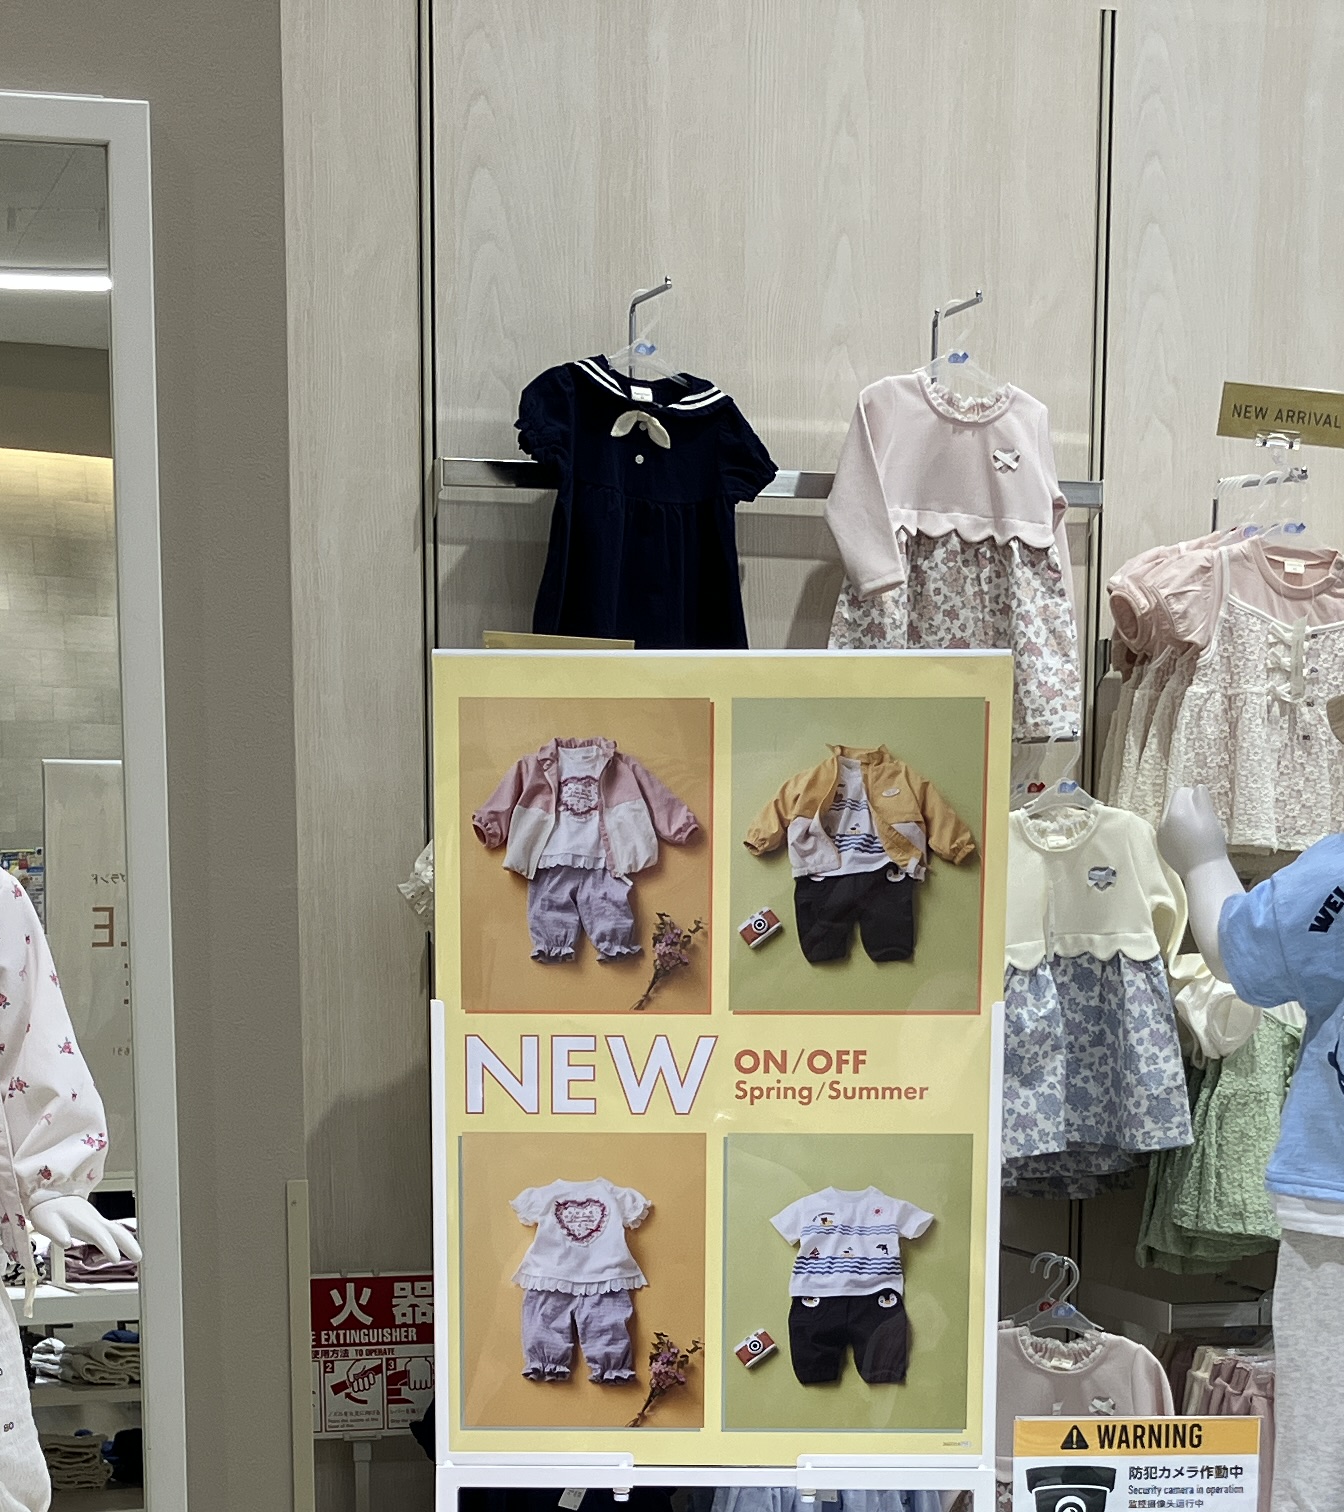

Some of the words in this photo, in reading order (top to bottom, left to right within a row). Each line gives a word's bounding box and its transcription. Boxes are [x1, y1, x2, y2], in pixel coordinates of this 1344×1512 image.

[1232, 404, 1268, 420] NEW
[1274, 409, 1341, 429] ARRIVAL
[465, 1034, 719, 1116] NEW
[734, 1049, 867, 1075] ON/OFF
[734, 1080, 929, 1105] Spring/Summer
[321, 1328, 417, 1345] EXTINGUISHER
[354, 1349, 364, 1357] TO
[365, 1347, 396, 1357] OPERATE
[326, 1363, 333, 1372] 2
[388, 1360, 395, 1370] 3
[1097, 1423, 1203, 1450] WARNING
[1128, 1464, 1244, 1480] 防犯カメラ作動中
[1128, 1485, 1162, 1497] Security
[1164, 1486, 1195, 1495] camera
[1197, 1484, 1204, 1495] in
[1206, 1484, 1244, 1496] operation
